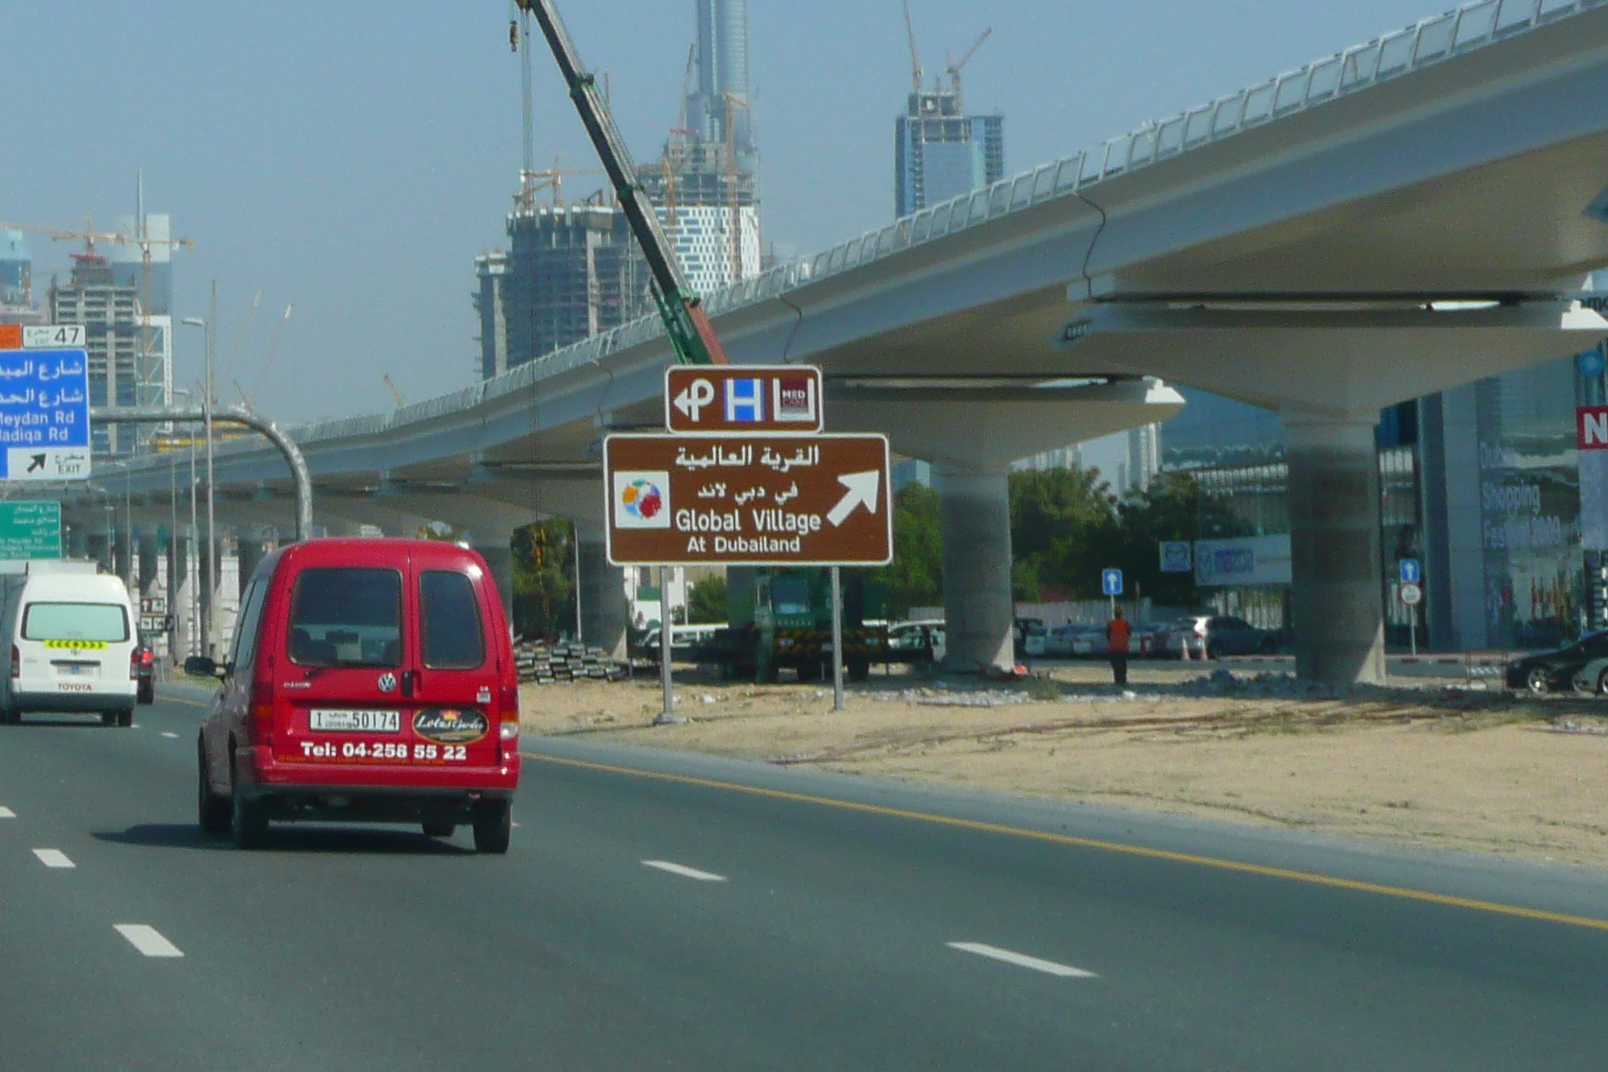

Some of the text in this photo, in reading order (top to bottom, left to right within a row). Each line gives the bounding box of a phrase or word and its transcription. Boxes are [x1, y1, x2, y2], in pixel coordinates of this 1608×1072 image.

[54, 327, 80, 344] 47
[38, 360, 83, 381] شارع
[38, 387, 84, 408] شارع
[782, 390, 806, 399] MED
[55, 410, 74, 424] Rd
[49, 427, 69, 441] Rd
[675, 444, 820, 472] القرية العالمية
[58, 464, 81, 474] EXIT
[697, 481, 799, 504] في دبي لاند
[675, 509, 822, 536] Global Village
[687, 536, 801, 553] At Dubailand
[57, 683, 92, 692] TOYOTA
[352, 712, 397, 729] 50174
[300, 741, 336, 757] Tel:
[414, 744, 437, 759] 55
[442, 745, 467, 760] 22
